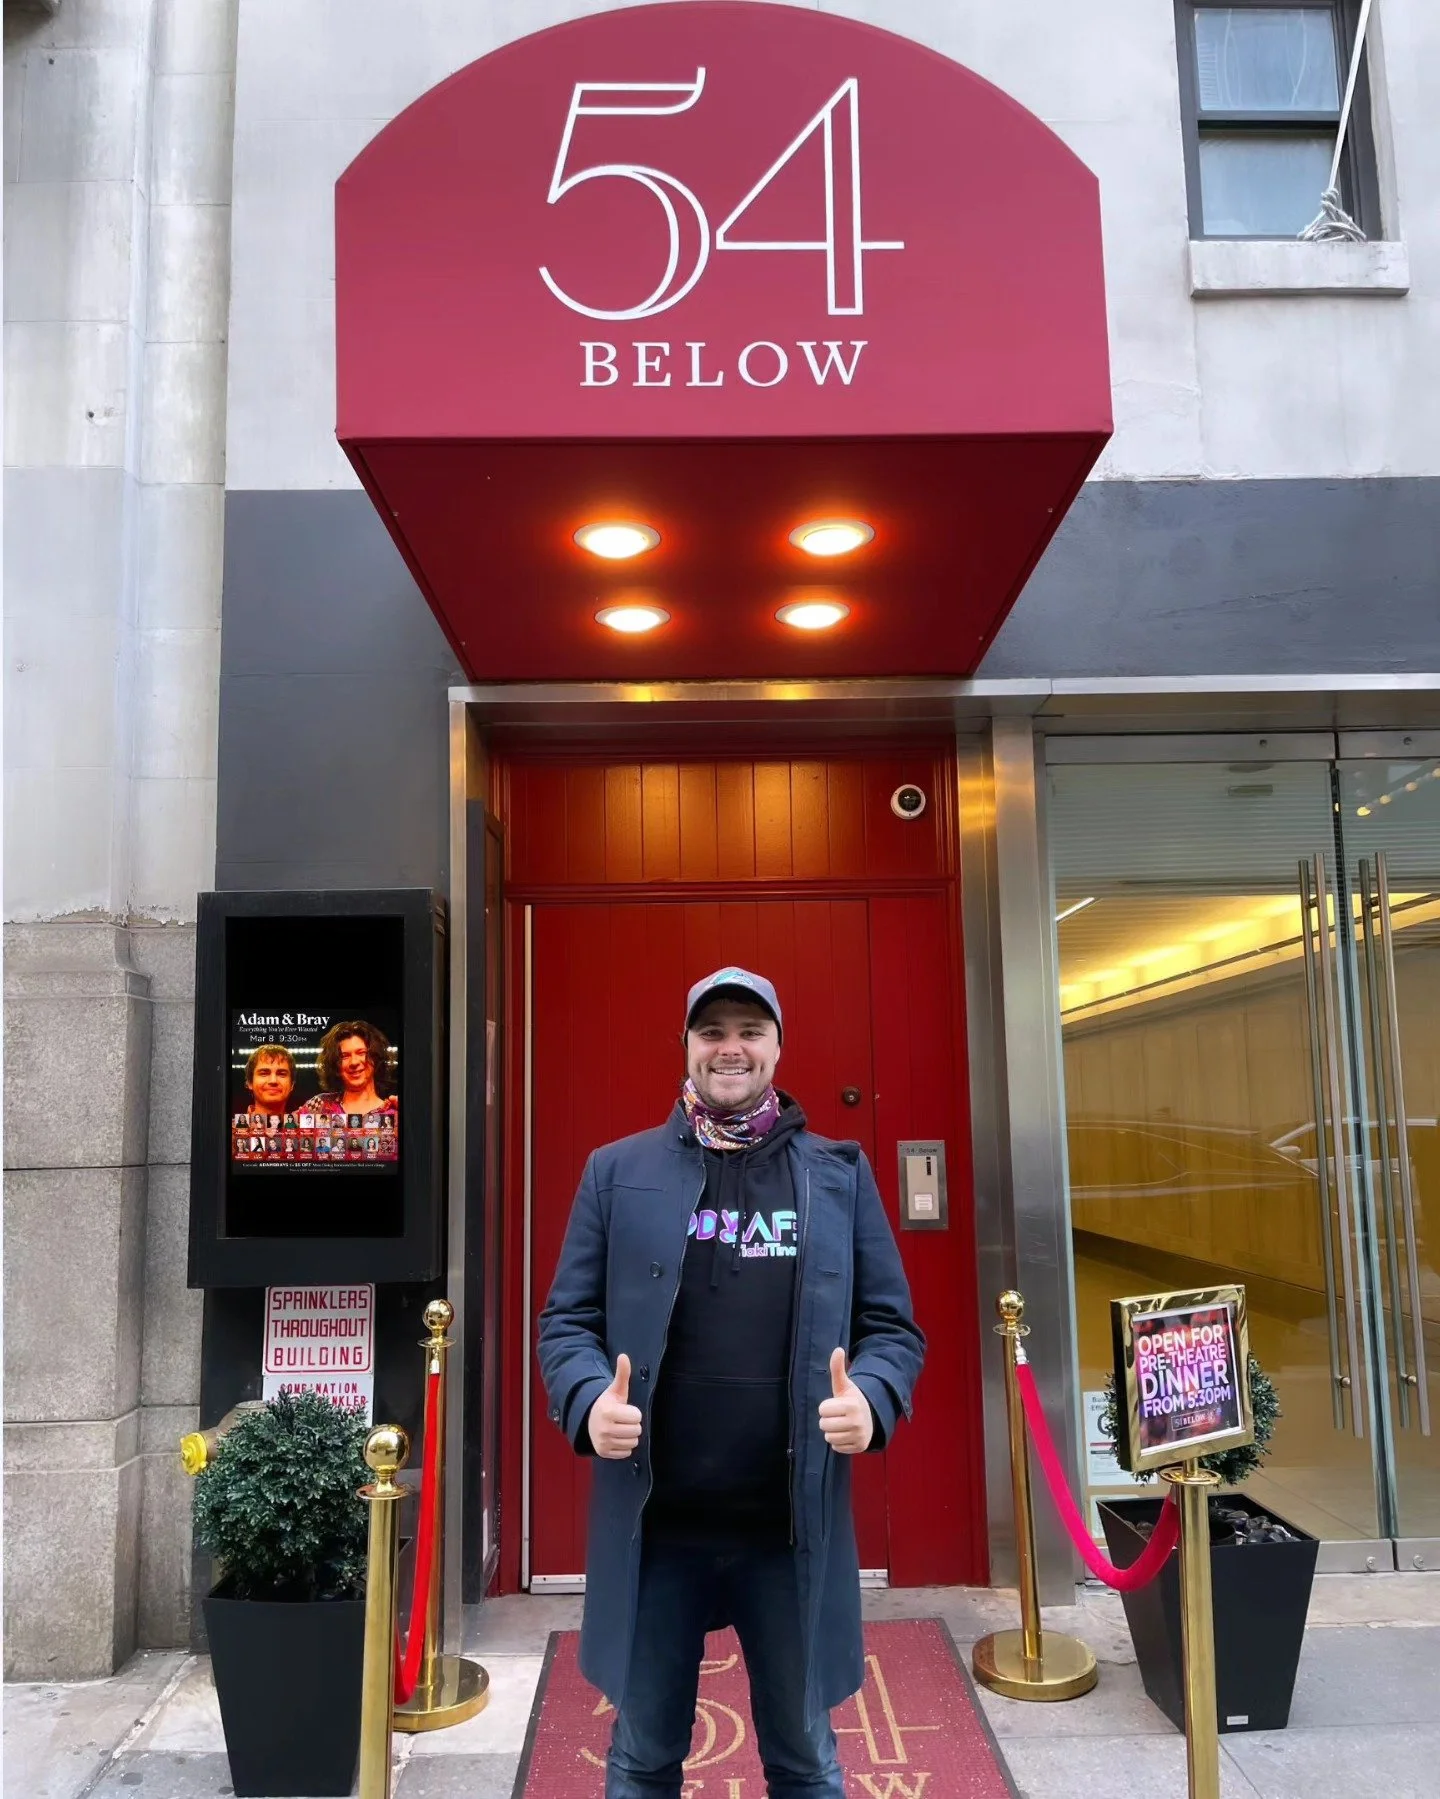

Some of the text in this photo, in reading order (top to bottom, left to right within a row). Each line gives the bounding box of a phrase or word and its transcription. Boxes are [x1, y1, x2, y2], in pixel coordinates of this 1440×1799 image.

[539, 66, 905, 320] 54
[580, 340, 868, 387] BELOW
[237, 1013, 330, 1029] Adam & Bray
[272, 1290, 368, 1310] SPRINKLERS
[272, 1318, 368, 1338] THROUGHOUT
[1138, 1324, 1224, 1356] OPEN FOR
[273, 1346, 363, 1366] BUILDING
[1139, 1342, 1227, 1373] PRE-THEATRE
[1141, 1359, 1230, 1400] DINNER
[1143, 1385, 1231, 1418] FROM 5:30PM
